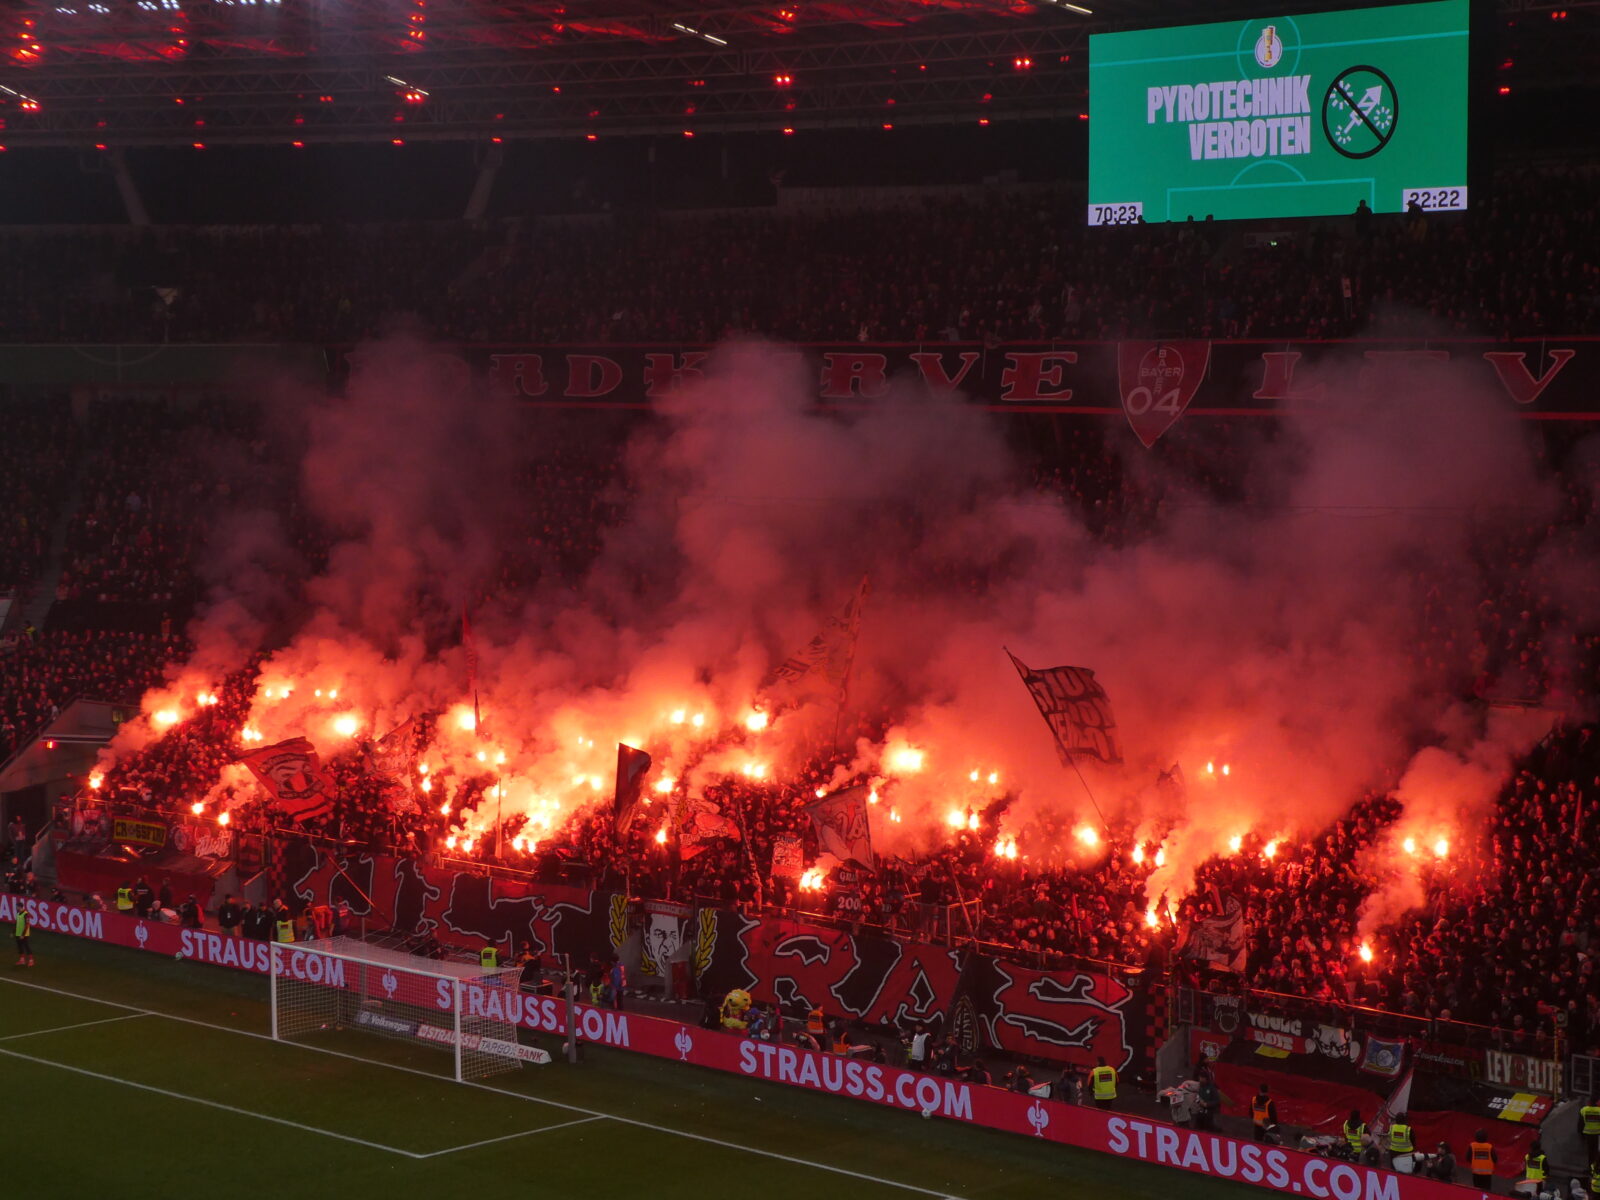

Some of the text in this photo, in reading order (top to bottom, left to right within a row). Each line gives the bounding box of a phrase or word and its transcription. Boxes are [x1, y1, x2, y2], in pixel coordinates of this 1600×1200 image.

[1147, 74, 1312, 124] PYROTECHNIK
[1189, 115, 1311, 160] VERBOTEN
[1095, 204, 1137, 223] 70:23
[1409, 190, 1460, 209] 22:22
[1141, 366, 1182, 377] BAYER
[1126, 386, 1182, 416] 04
[180, 928, 346, 988] STRAUSS.COM
[436, 978, 630, 1047] STRAUSS.COM
[427, 1026, 471, 1048] STRAUS
[739, 1039, 974, 1121] STRAUSS.COM
[1486, 1050, 1512, 1083] LEV
[1108, 1116, 1401, 1200] STRAUSS.COM
